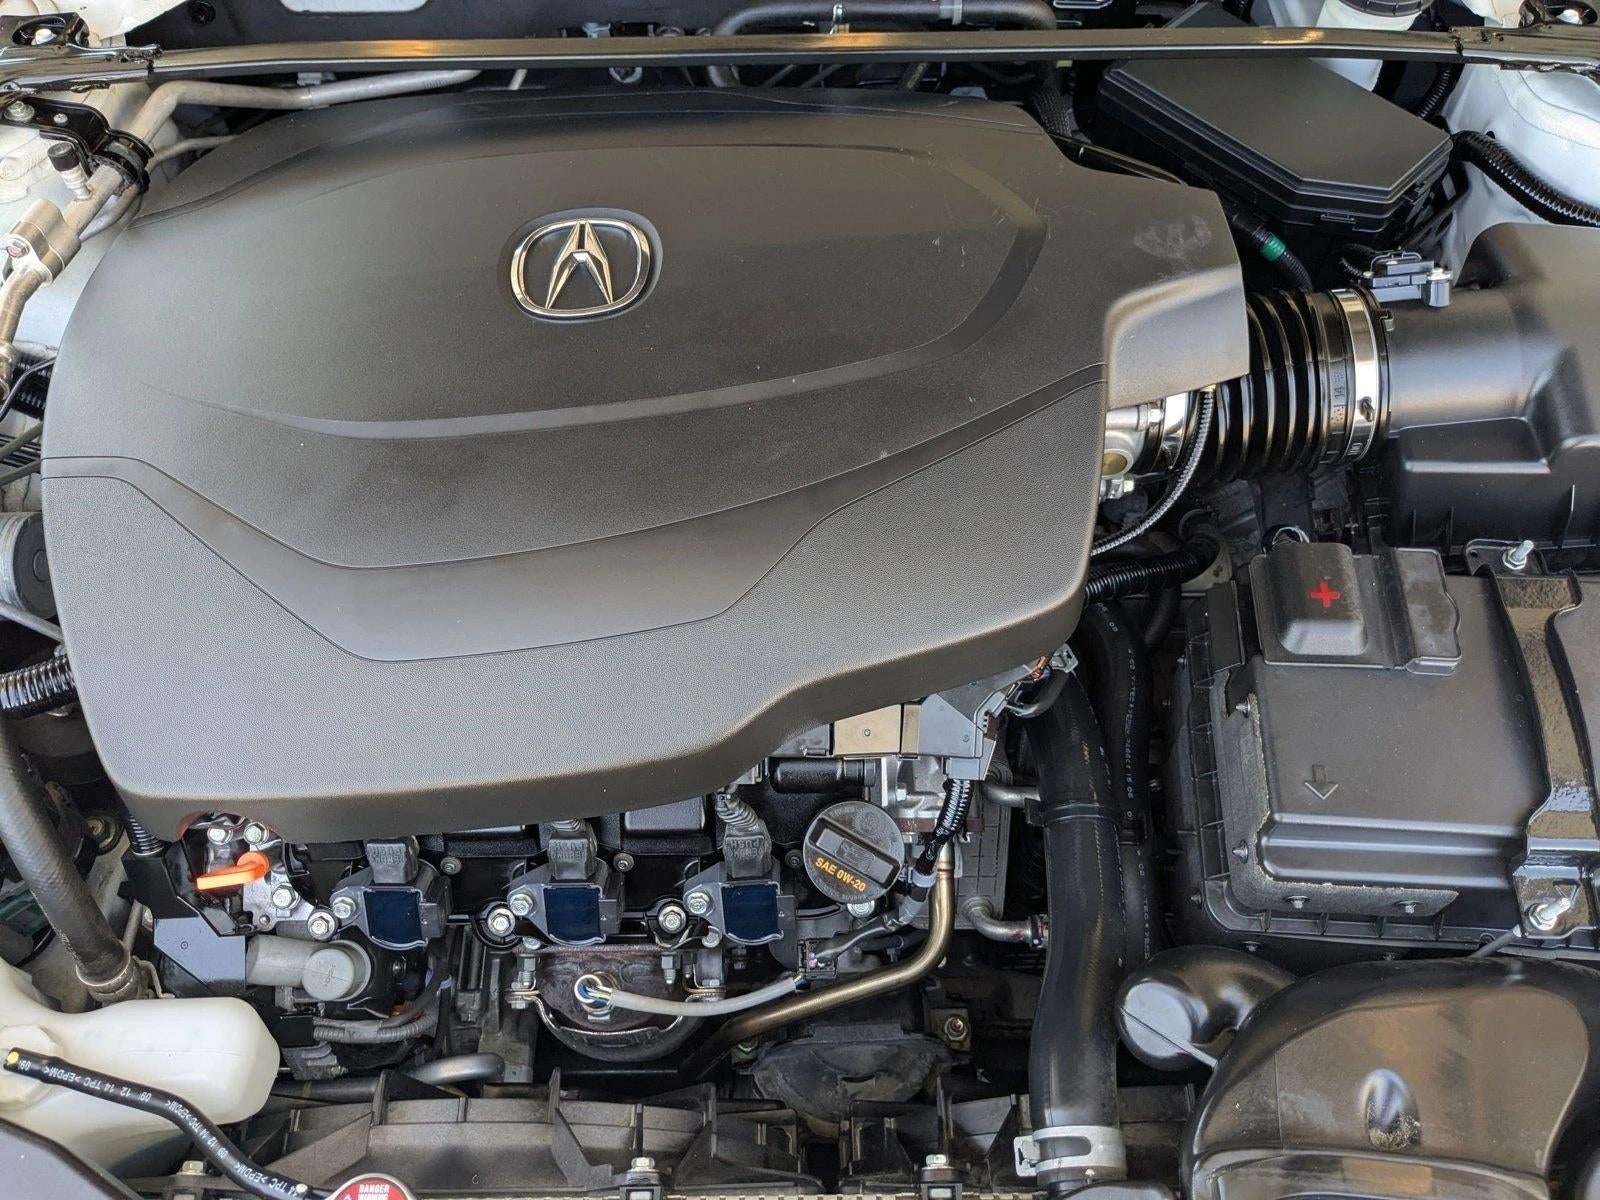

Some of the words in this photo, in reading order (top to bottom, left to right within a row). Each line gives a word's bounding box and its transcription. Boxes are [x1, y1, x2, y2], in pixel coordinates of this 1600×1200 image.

[730, 839, 760, 849] PUSH
[815, 857, 837, 875] SAE
[836, 869, 866, 892] 0W-20
[82, 1077, 102, 1092] TPC
[104, 1083, 115, 1093] 14
[120, 1086, 132, 1097] 12
[188, 1117, 203, 1132] TPC
[207, 1136, 218, 1148] 12
[268, 1178, 287, 1192] TPC
[359, 1184, 390, 1193] DANGER
